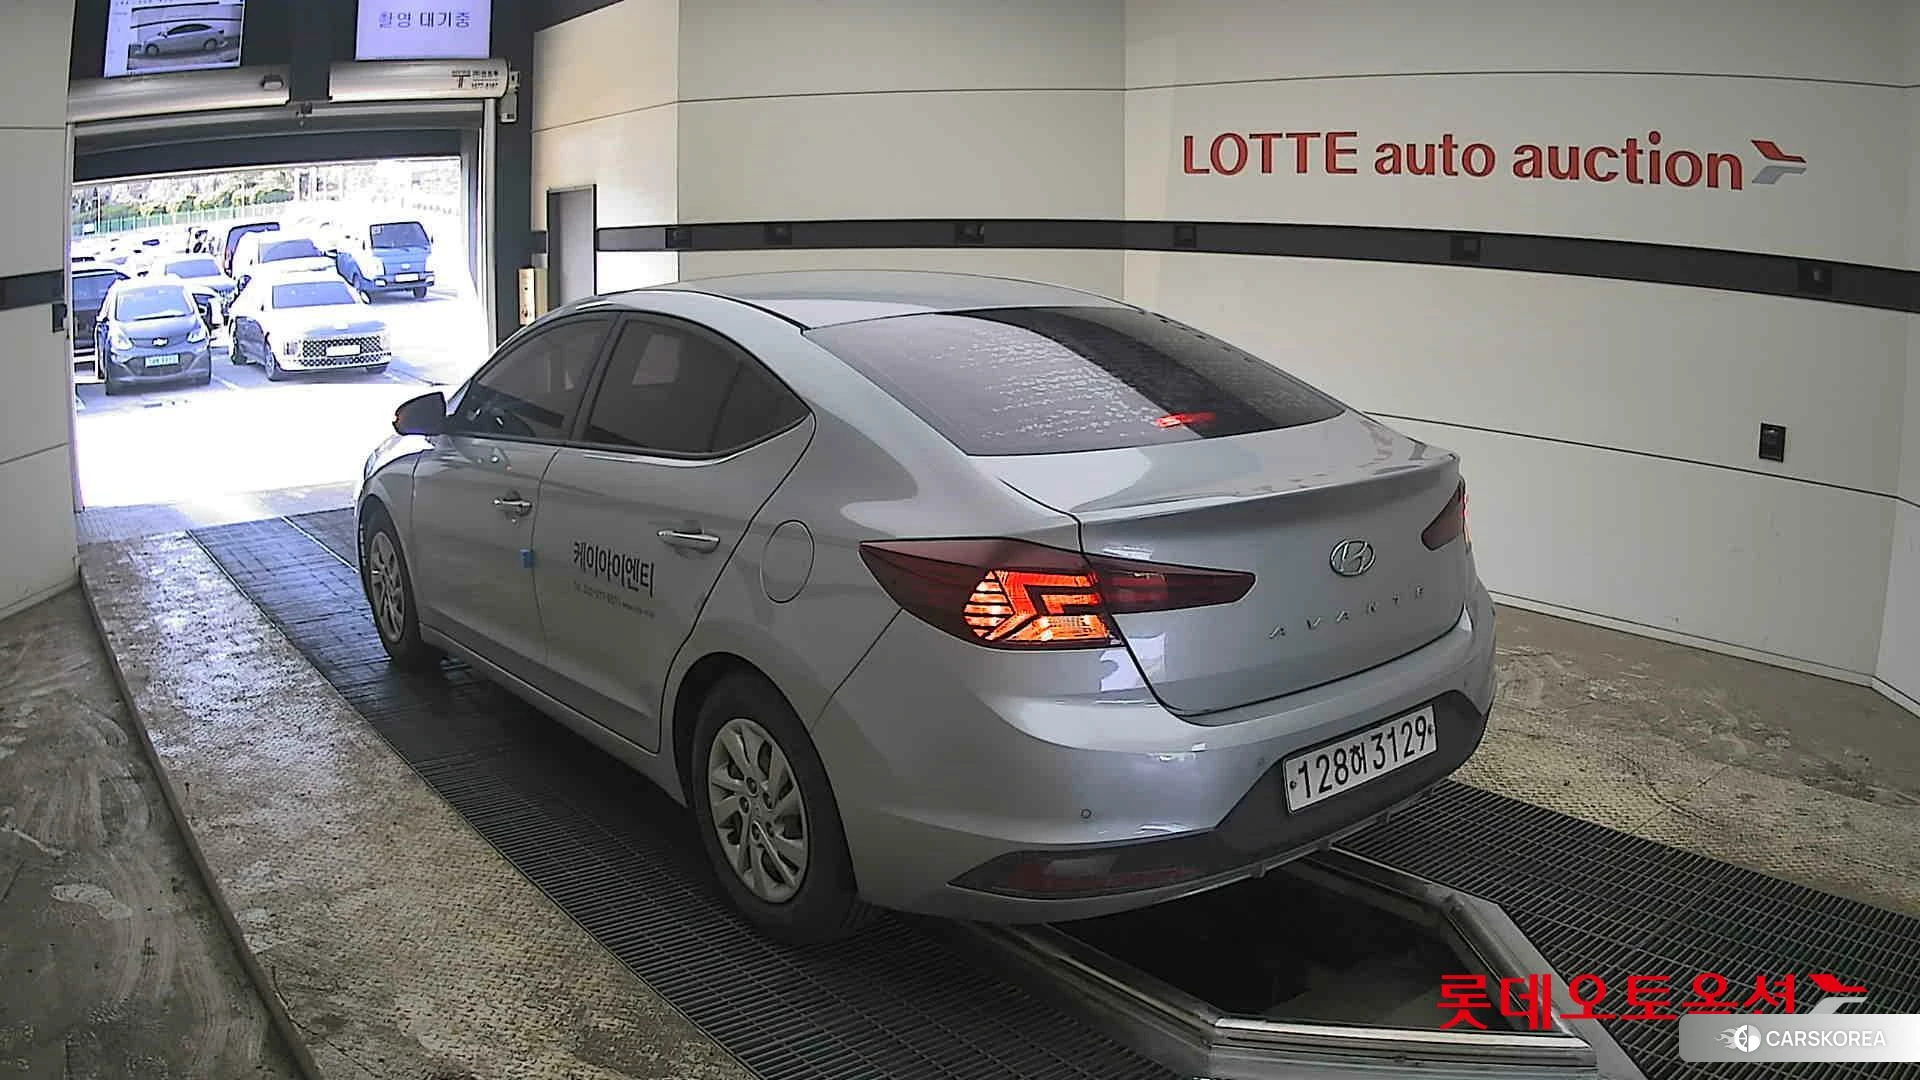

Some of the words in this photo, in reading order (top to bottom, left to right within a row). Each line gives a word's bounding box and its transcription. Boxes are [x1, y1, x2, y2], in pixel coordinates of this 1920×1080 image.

[419, 11, 471, 28] 대기중
[1184, 131, 1358, 176] LOTTE
[1374, 133, 1496, 178] auto
[1512, 130, 1743, 190] auction
[573, 541, 655, 599] 케이아이엔티
